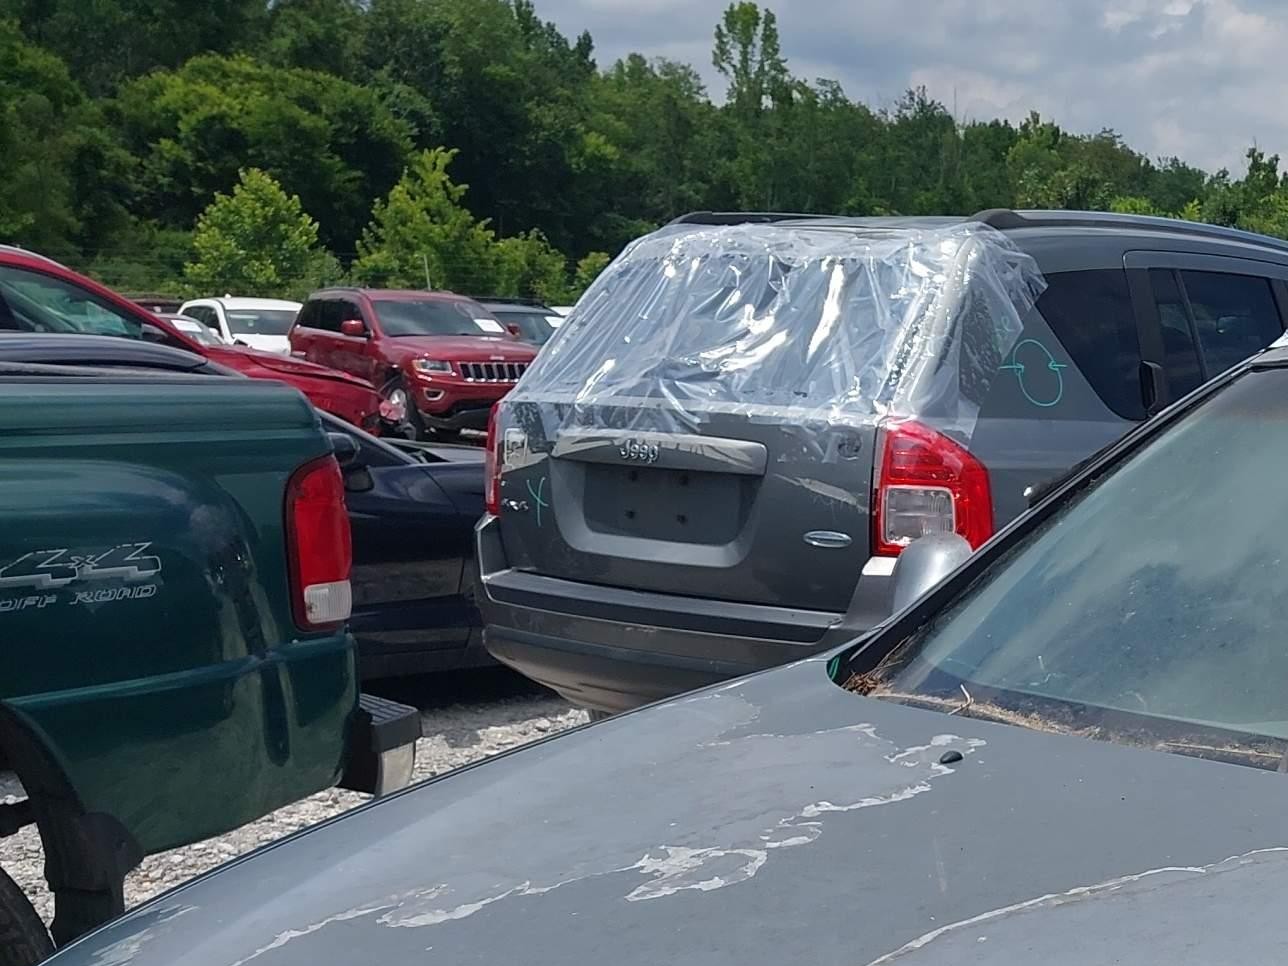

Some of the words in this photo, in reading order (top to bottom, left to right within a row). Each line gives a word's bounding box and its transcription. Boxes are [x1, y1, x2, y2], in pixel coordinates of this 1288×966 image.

[620, 439, 659, 464] Jeep
[0, 542, 161, 590] 4x4
[0, 594, 57, 611] OFF
[69, 584, 156, 605] ROAD
